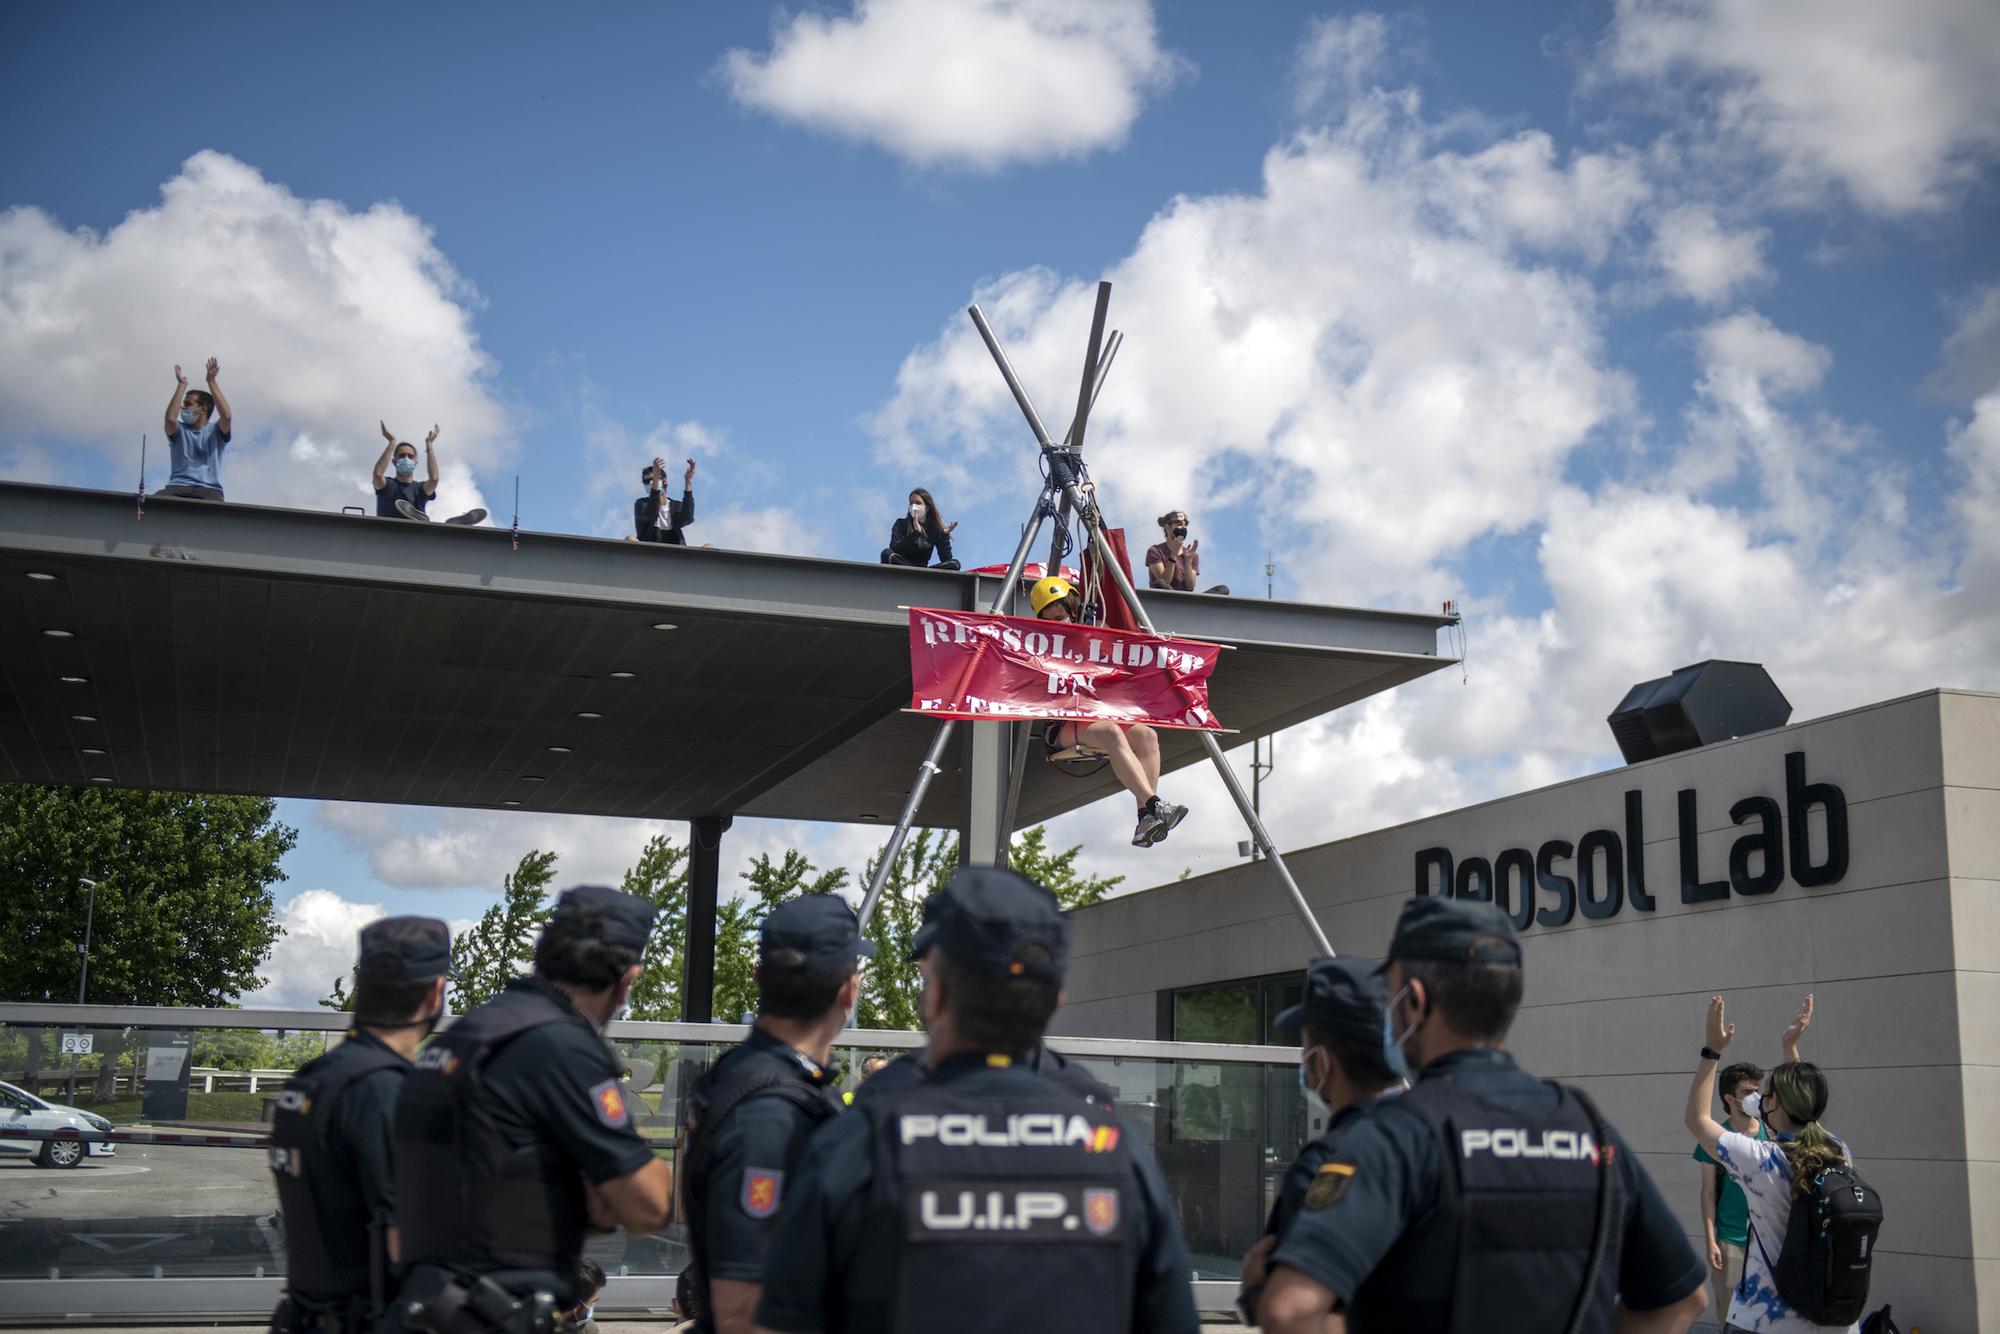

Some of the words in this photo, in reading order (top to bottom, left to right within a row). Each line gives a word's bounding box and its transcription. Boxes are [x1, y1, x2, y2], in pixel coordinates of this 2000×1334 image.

[1678, 751, 1849, 905] Lab
[900, 1114, 1091, 1146] POLICIA
[1462, 1129, 1598, 1161] POLICIA
[921, 1191, 1080, 1230] U.I.P.
